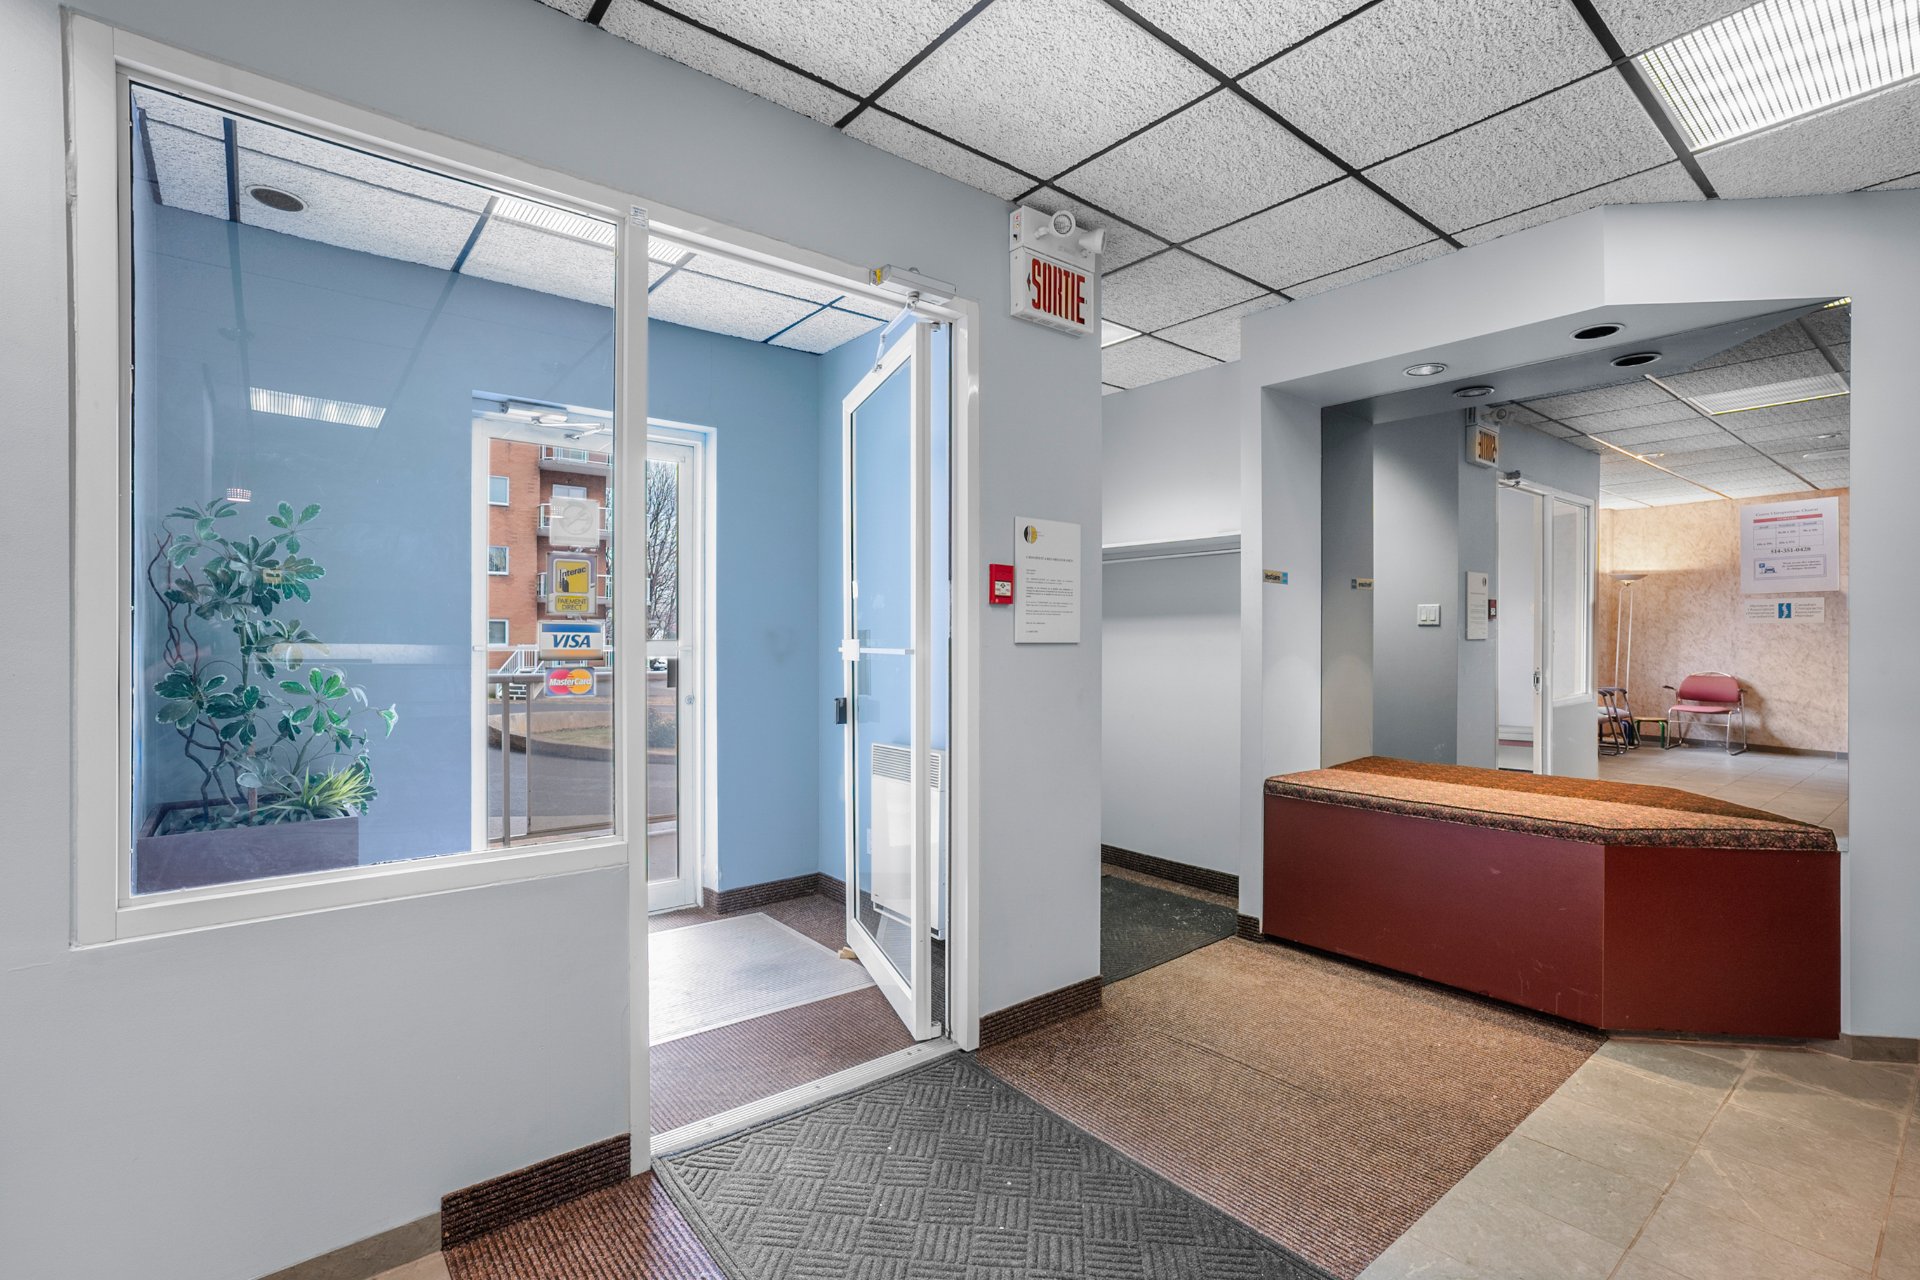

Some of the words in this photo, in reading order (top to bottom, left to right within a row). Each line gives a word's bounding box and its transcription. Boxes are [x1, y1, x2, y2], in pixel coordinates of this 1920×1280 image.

[1031, 257, 1086, 326] SORTIE
[559, 566, 587, 579] Interac
[552, 634, 591, 648] VISA
[548, 678, 593, 687] MasterCard
